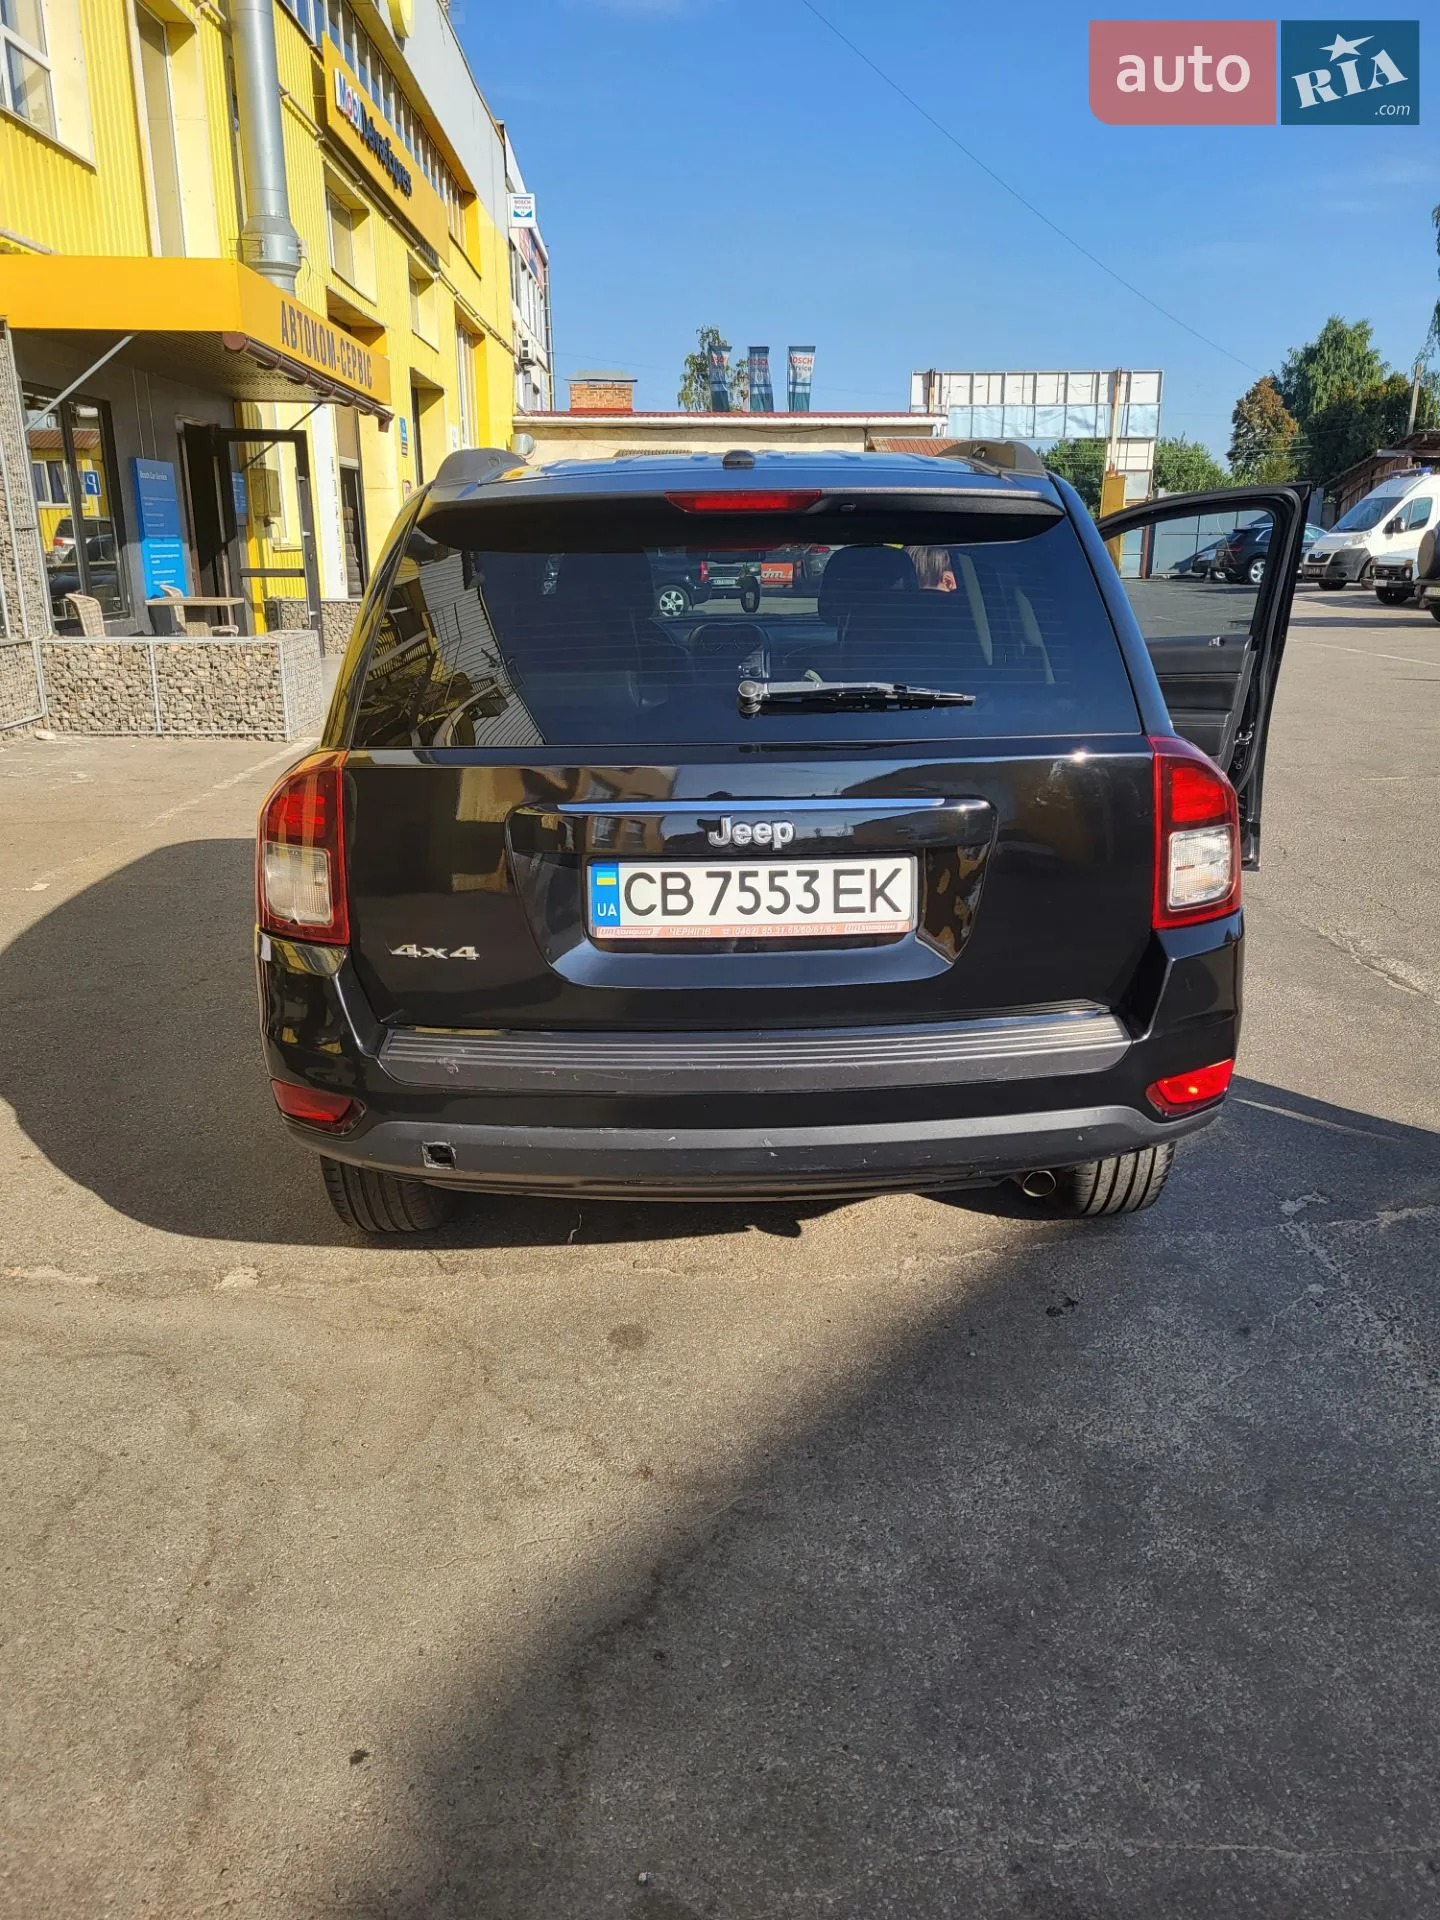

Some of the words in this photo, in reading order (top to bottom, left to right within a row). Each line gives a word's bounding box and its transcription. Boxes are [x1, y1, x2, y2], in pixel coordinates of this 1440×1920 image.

[281, 300, 373, 390] АВТОКОМ-СЕРВІС
[708, 815, 795, 850] Jeep
[597, 903, 617, 917] UA
[624, 871, 694, 917] CB
[706, 869, 820, 916] 7553
[833, 868, 903, 914] EK
[391, 944, 480, 961] 4x4
